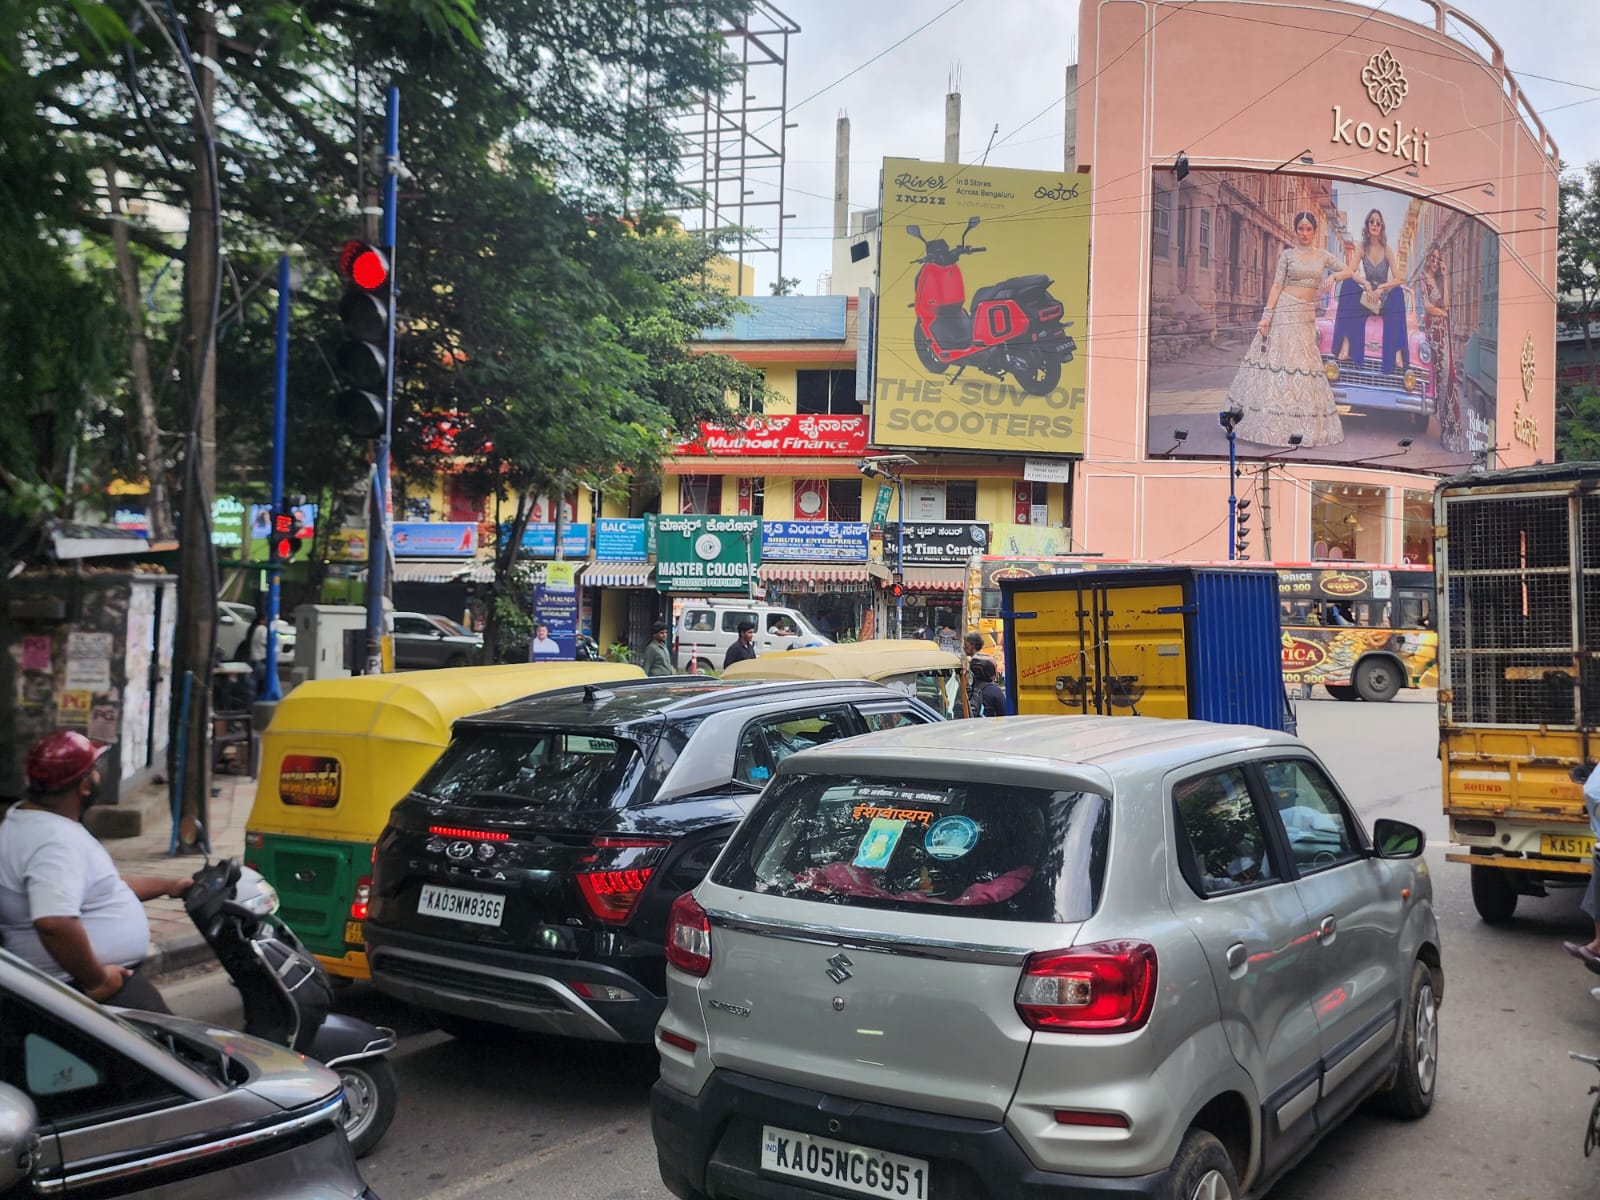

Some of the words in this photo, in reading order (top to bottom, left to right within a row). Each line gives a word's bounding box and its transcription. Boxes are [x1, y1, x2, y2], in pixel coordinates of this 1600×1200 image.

[1331, 104, 1430, 167] koskii
[895, 173, 948, 192] River
[970, 179, 992, 187] Stores
[896, 194, 946, 205] INDIE
[956, 188, 980, 196] Across
[981, 189, 1015, 199] Bengaluru
[876, 377, 944, 403] THE
[960, 381, 1028, 407] SUV
[1046, 386, 1086, 410] OF
[886, 408, 1073, 439] SCOOTERS
[706, 437, 779, 450] Muthoot
[782, 437, 849, 450] Finance
[806, 537, 862, 545] ENTERPRISES
[915, 543, 943, 555] Time
[946, 544, 985, 555] Center
[658, 562, 703, 576] MASTER
[706, 562, 758, 577] COLOGNE
[673, 578, 707, 587] EXCLUSIVE
[708, 578, 742, 587] PERFUMES
[1282, 573, 1313, 581] PRICE
[1293, 584, 1311, 592] 300
[1304, 674, 1325, 684] 300
[62, 693, 87, 709] PG
[1463, 782, 1502, 793] SOUND
[853, 802, 934, 828] ईशावास्यम्
[409, 860, 506, 881] CRETA
[427, 889, 501, 920] KA03NM8366
[765, 1144, 777, 1153] IND
[777, 1137, 923, 1200] KA05NC6951
